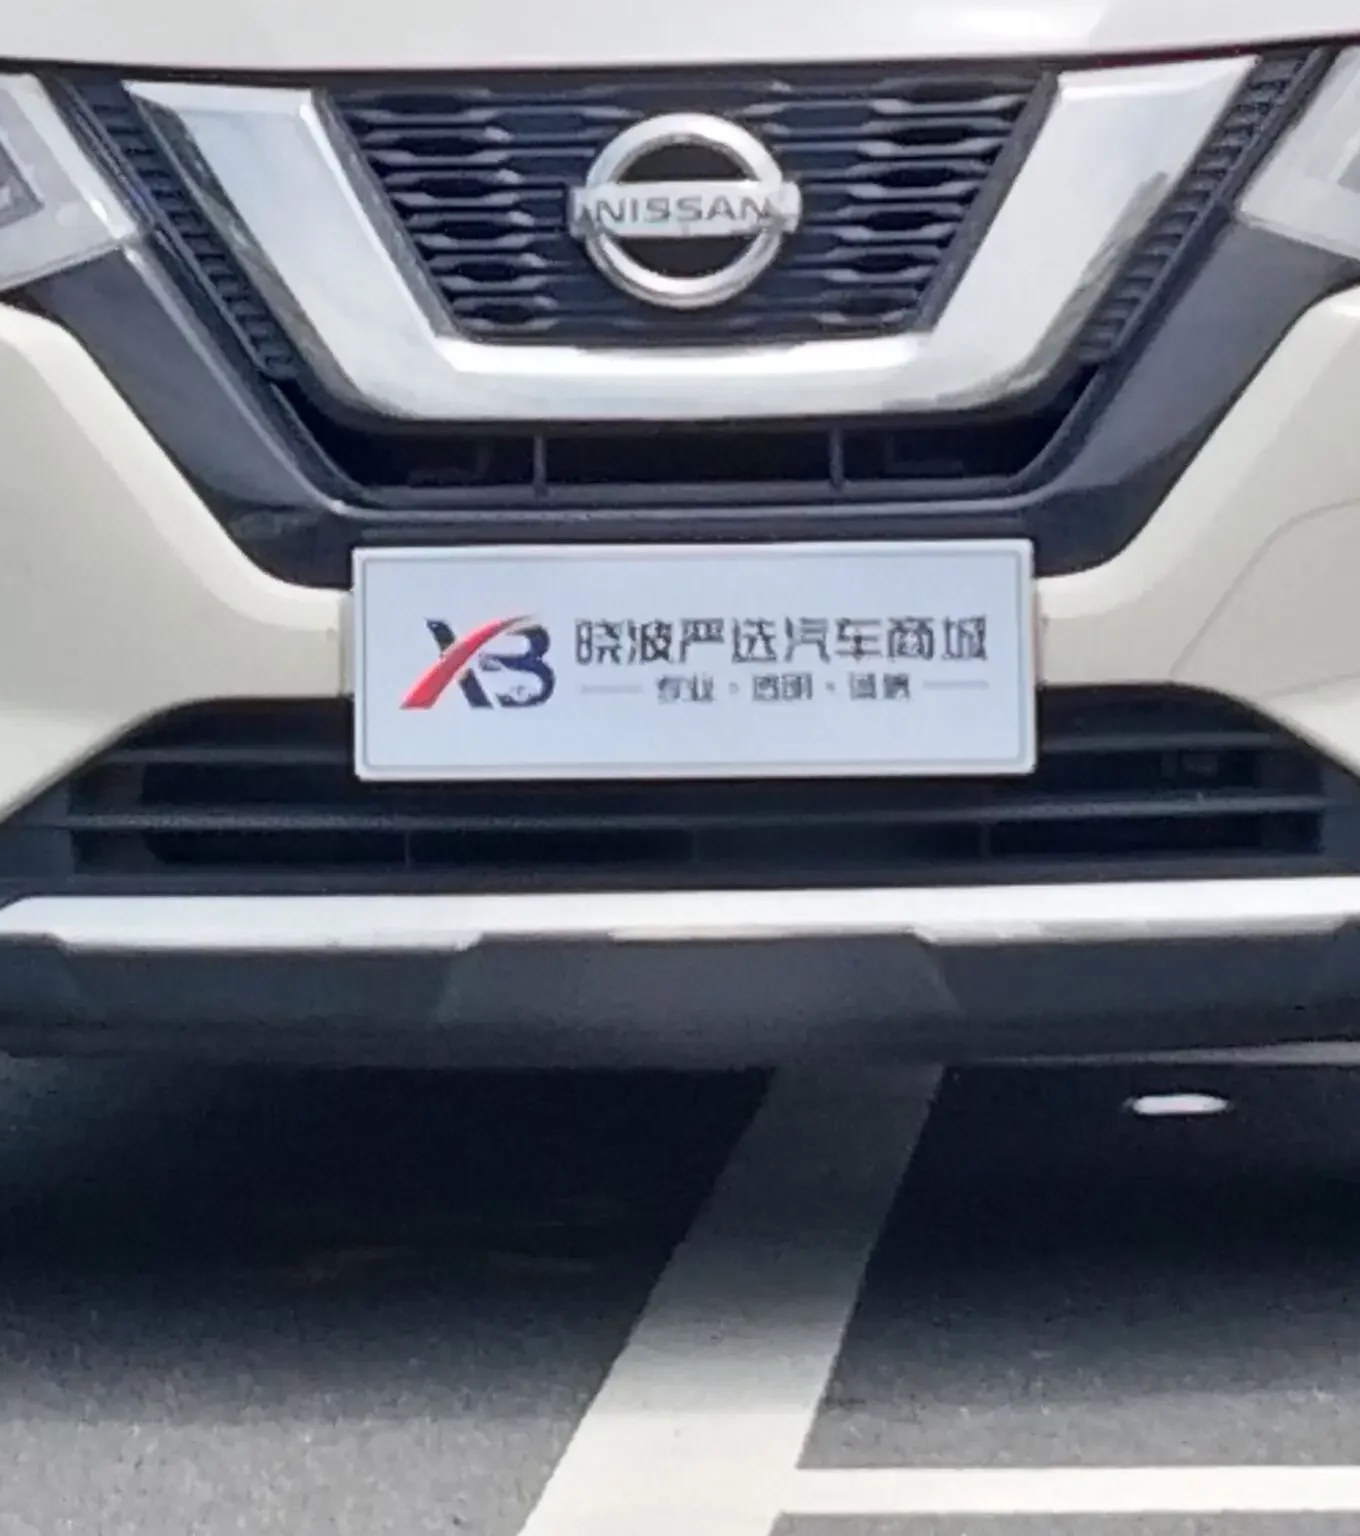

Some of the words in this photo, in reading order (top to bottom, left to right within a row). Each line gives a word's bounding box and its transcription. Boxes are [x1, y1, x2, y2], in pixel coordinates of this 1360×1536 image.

[595, 194, 772, 224] NISSAN
[574, 615, 988, 664] 晓波严选汽车商城
